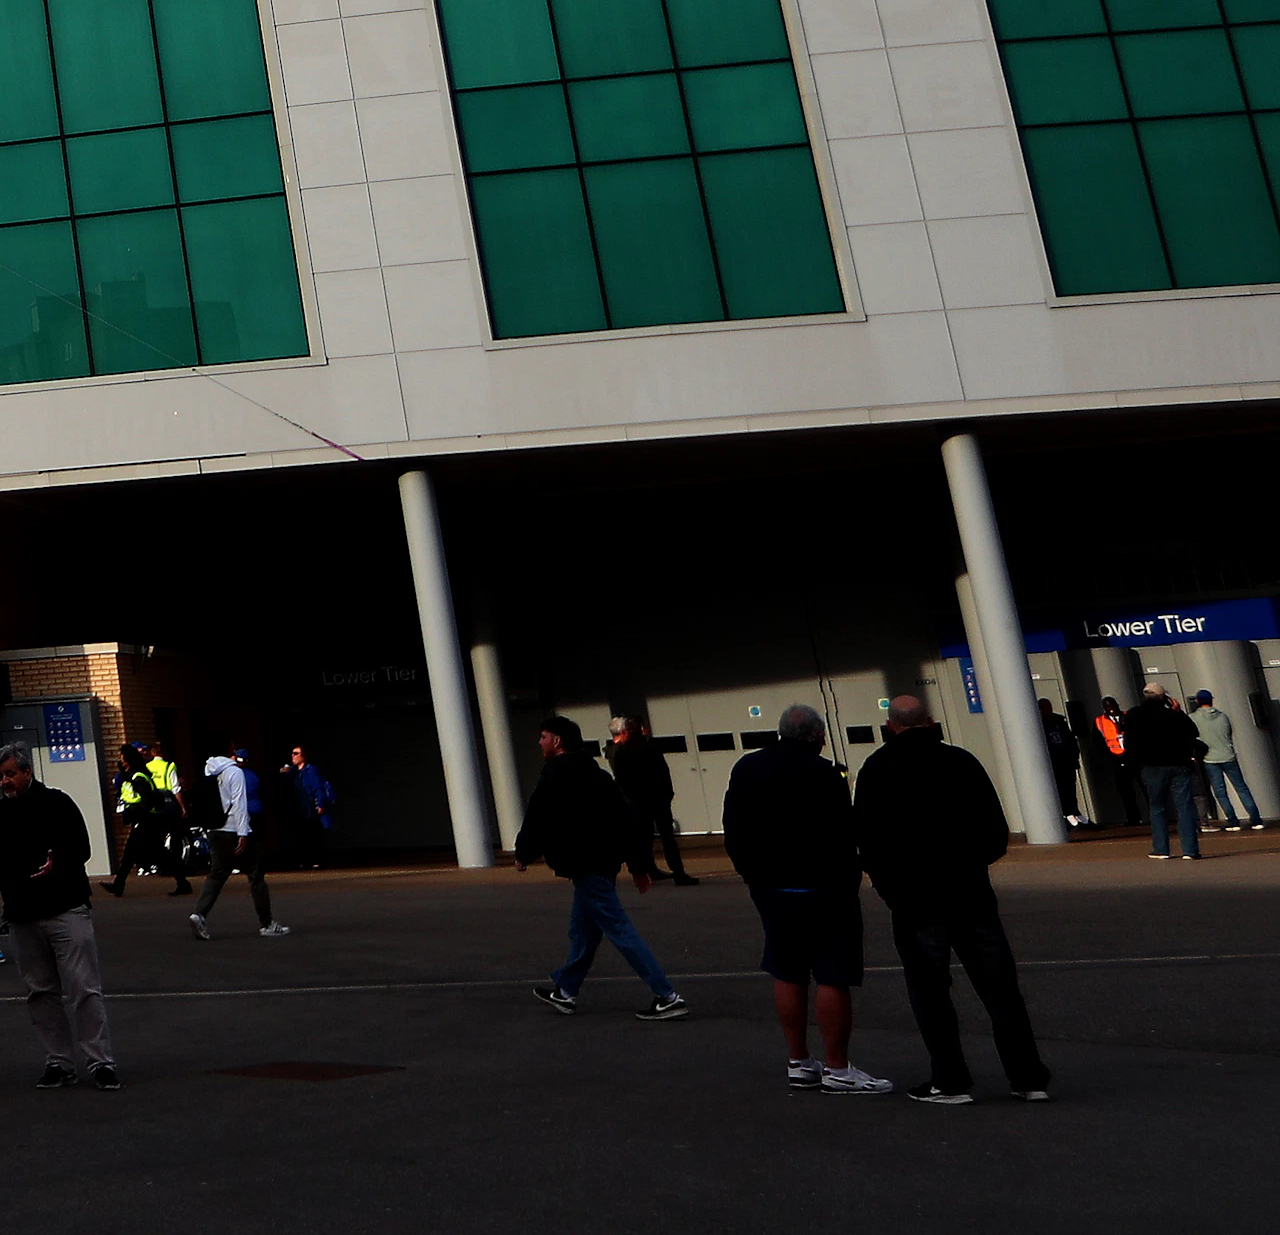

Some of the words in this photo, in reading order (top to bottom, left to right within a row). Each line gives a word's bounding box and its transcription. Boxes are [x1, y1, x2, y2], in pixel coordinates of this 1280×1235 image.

[1084, 620, 1154, 638] Lower
[1158, 615, 1206, 634] Tier
[321, 669, 378, 686] Lower
[381, 666, 417, 682] Tier
